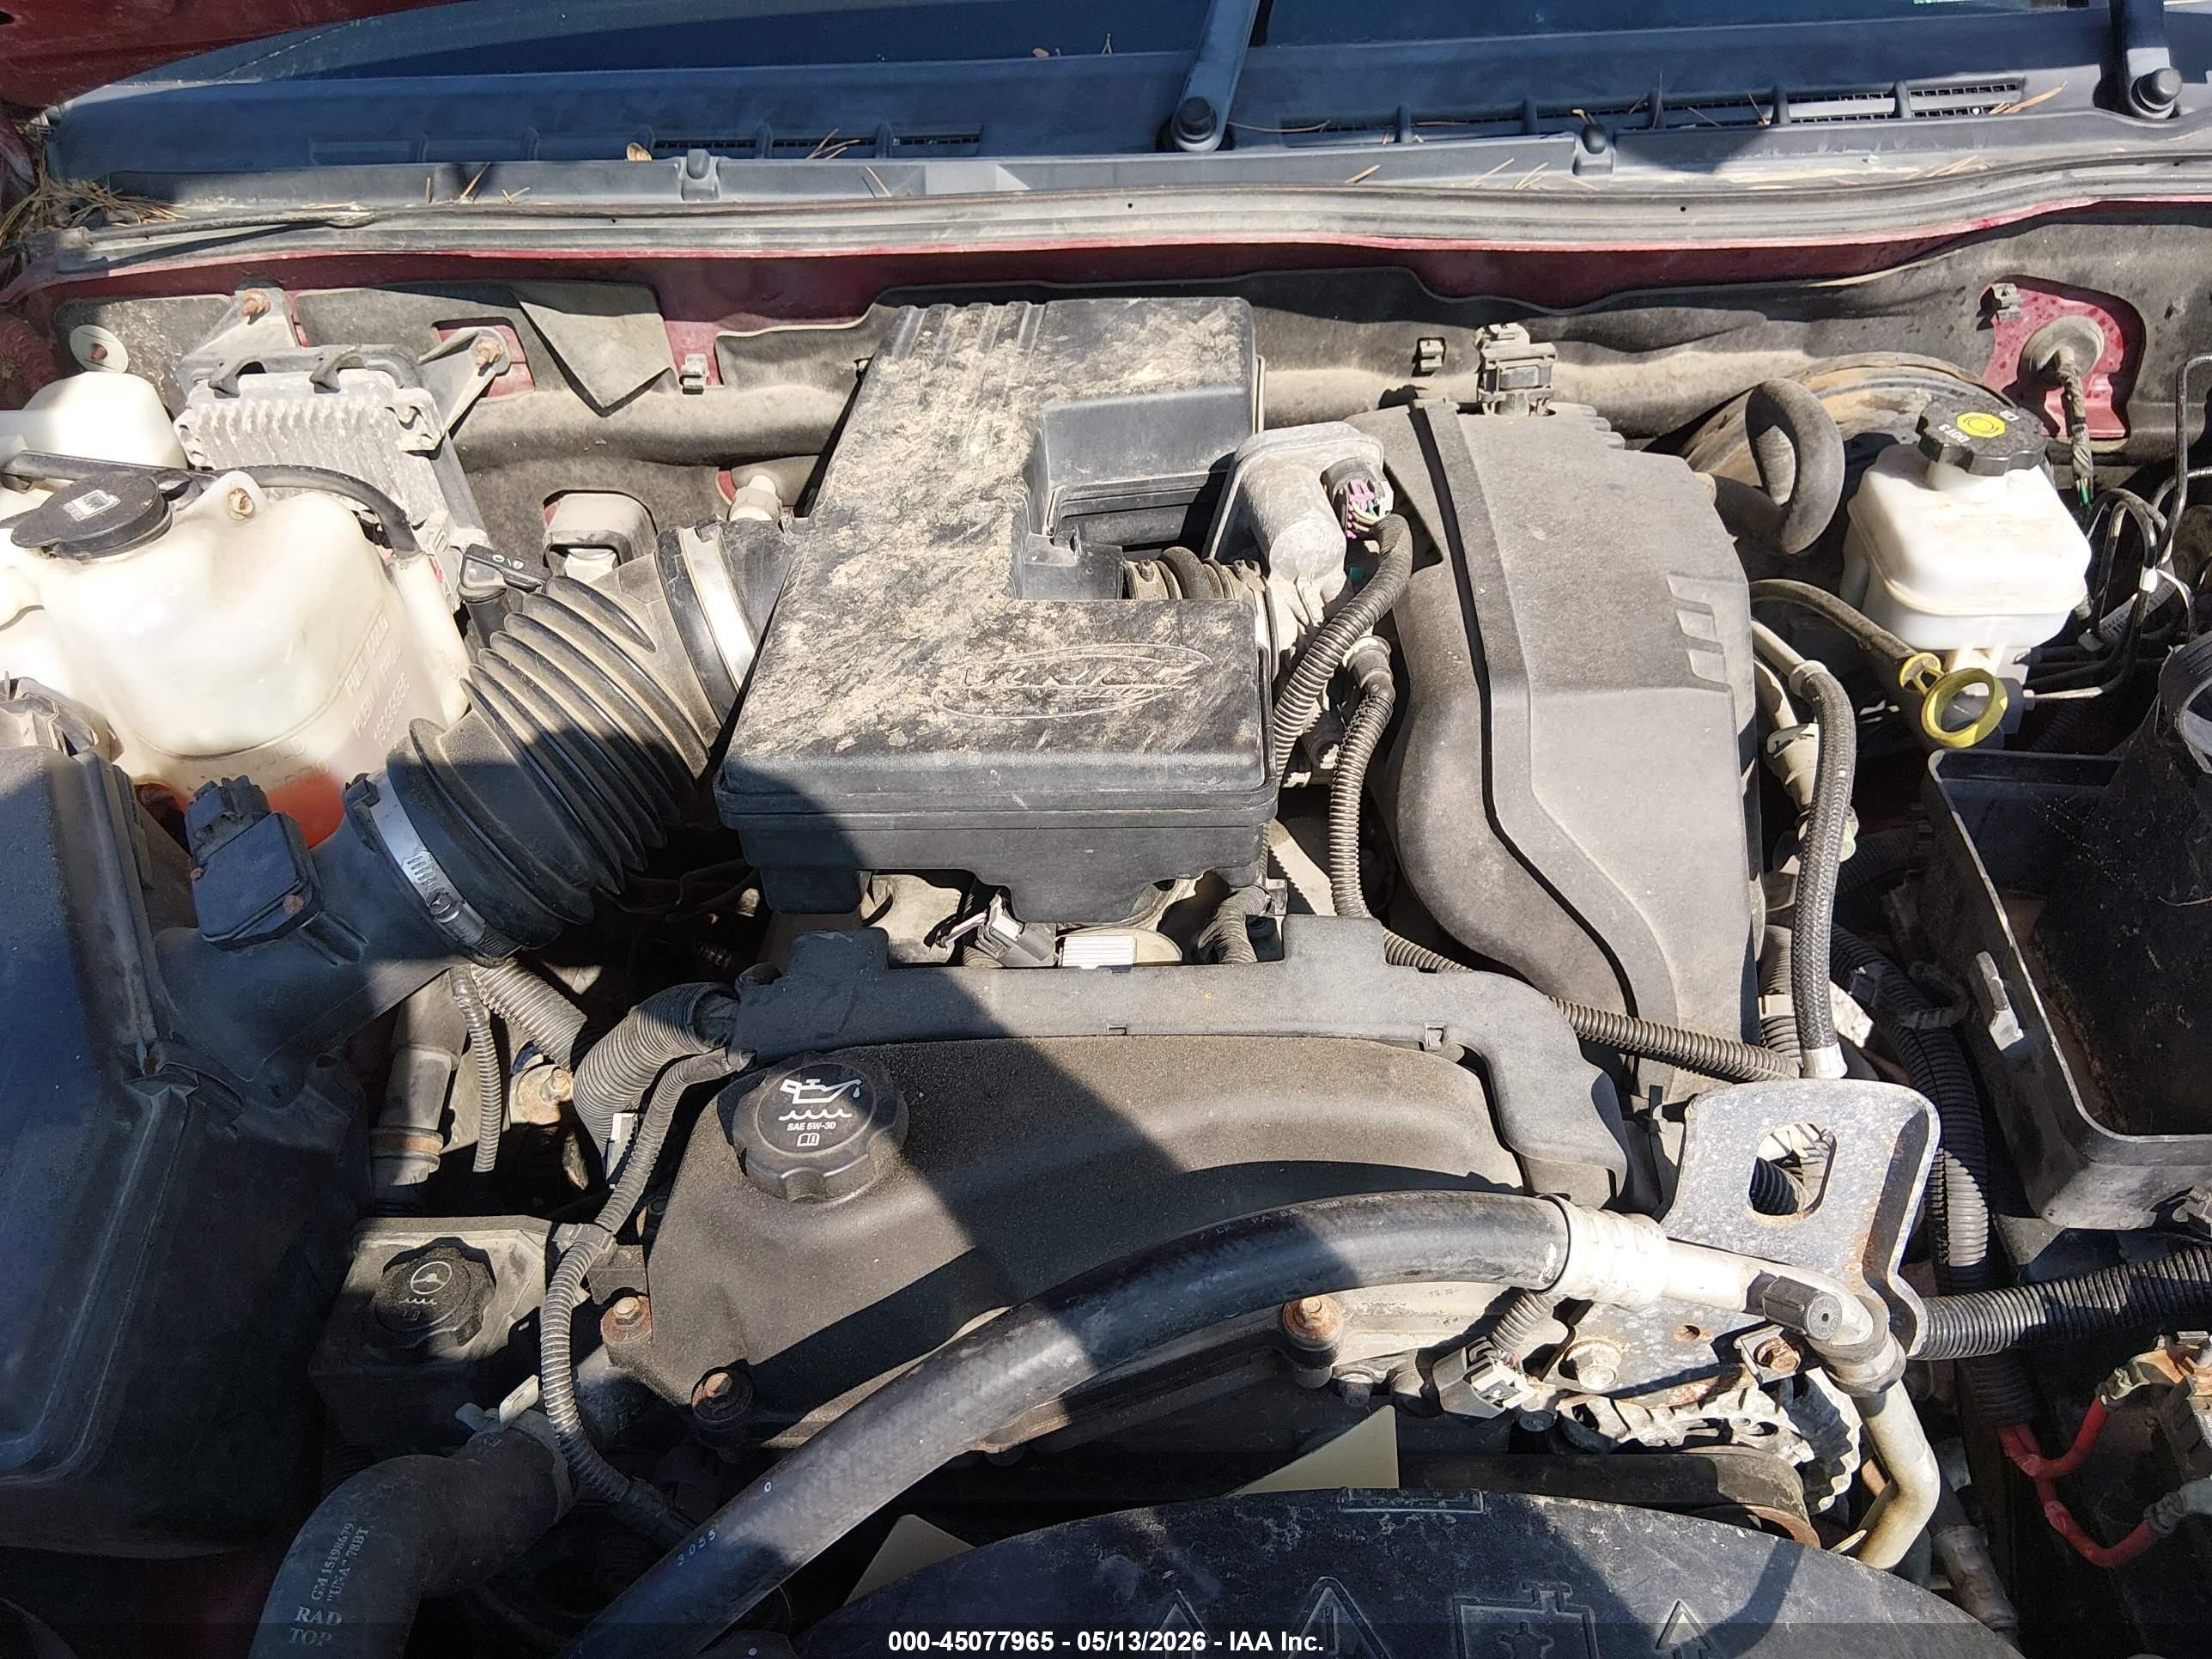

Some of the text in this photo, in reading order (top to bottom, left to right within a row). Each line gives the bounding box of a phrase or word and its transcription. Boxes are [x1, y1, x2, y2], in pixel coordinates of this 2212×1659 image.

[787, 1121, 836, 1131] SAE 5W-30
[311, 1577, 329, 1602] GM
[295, 1606, 343, 1626] RAD
[289, 1627, 333, 1648] TOP
